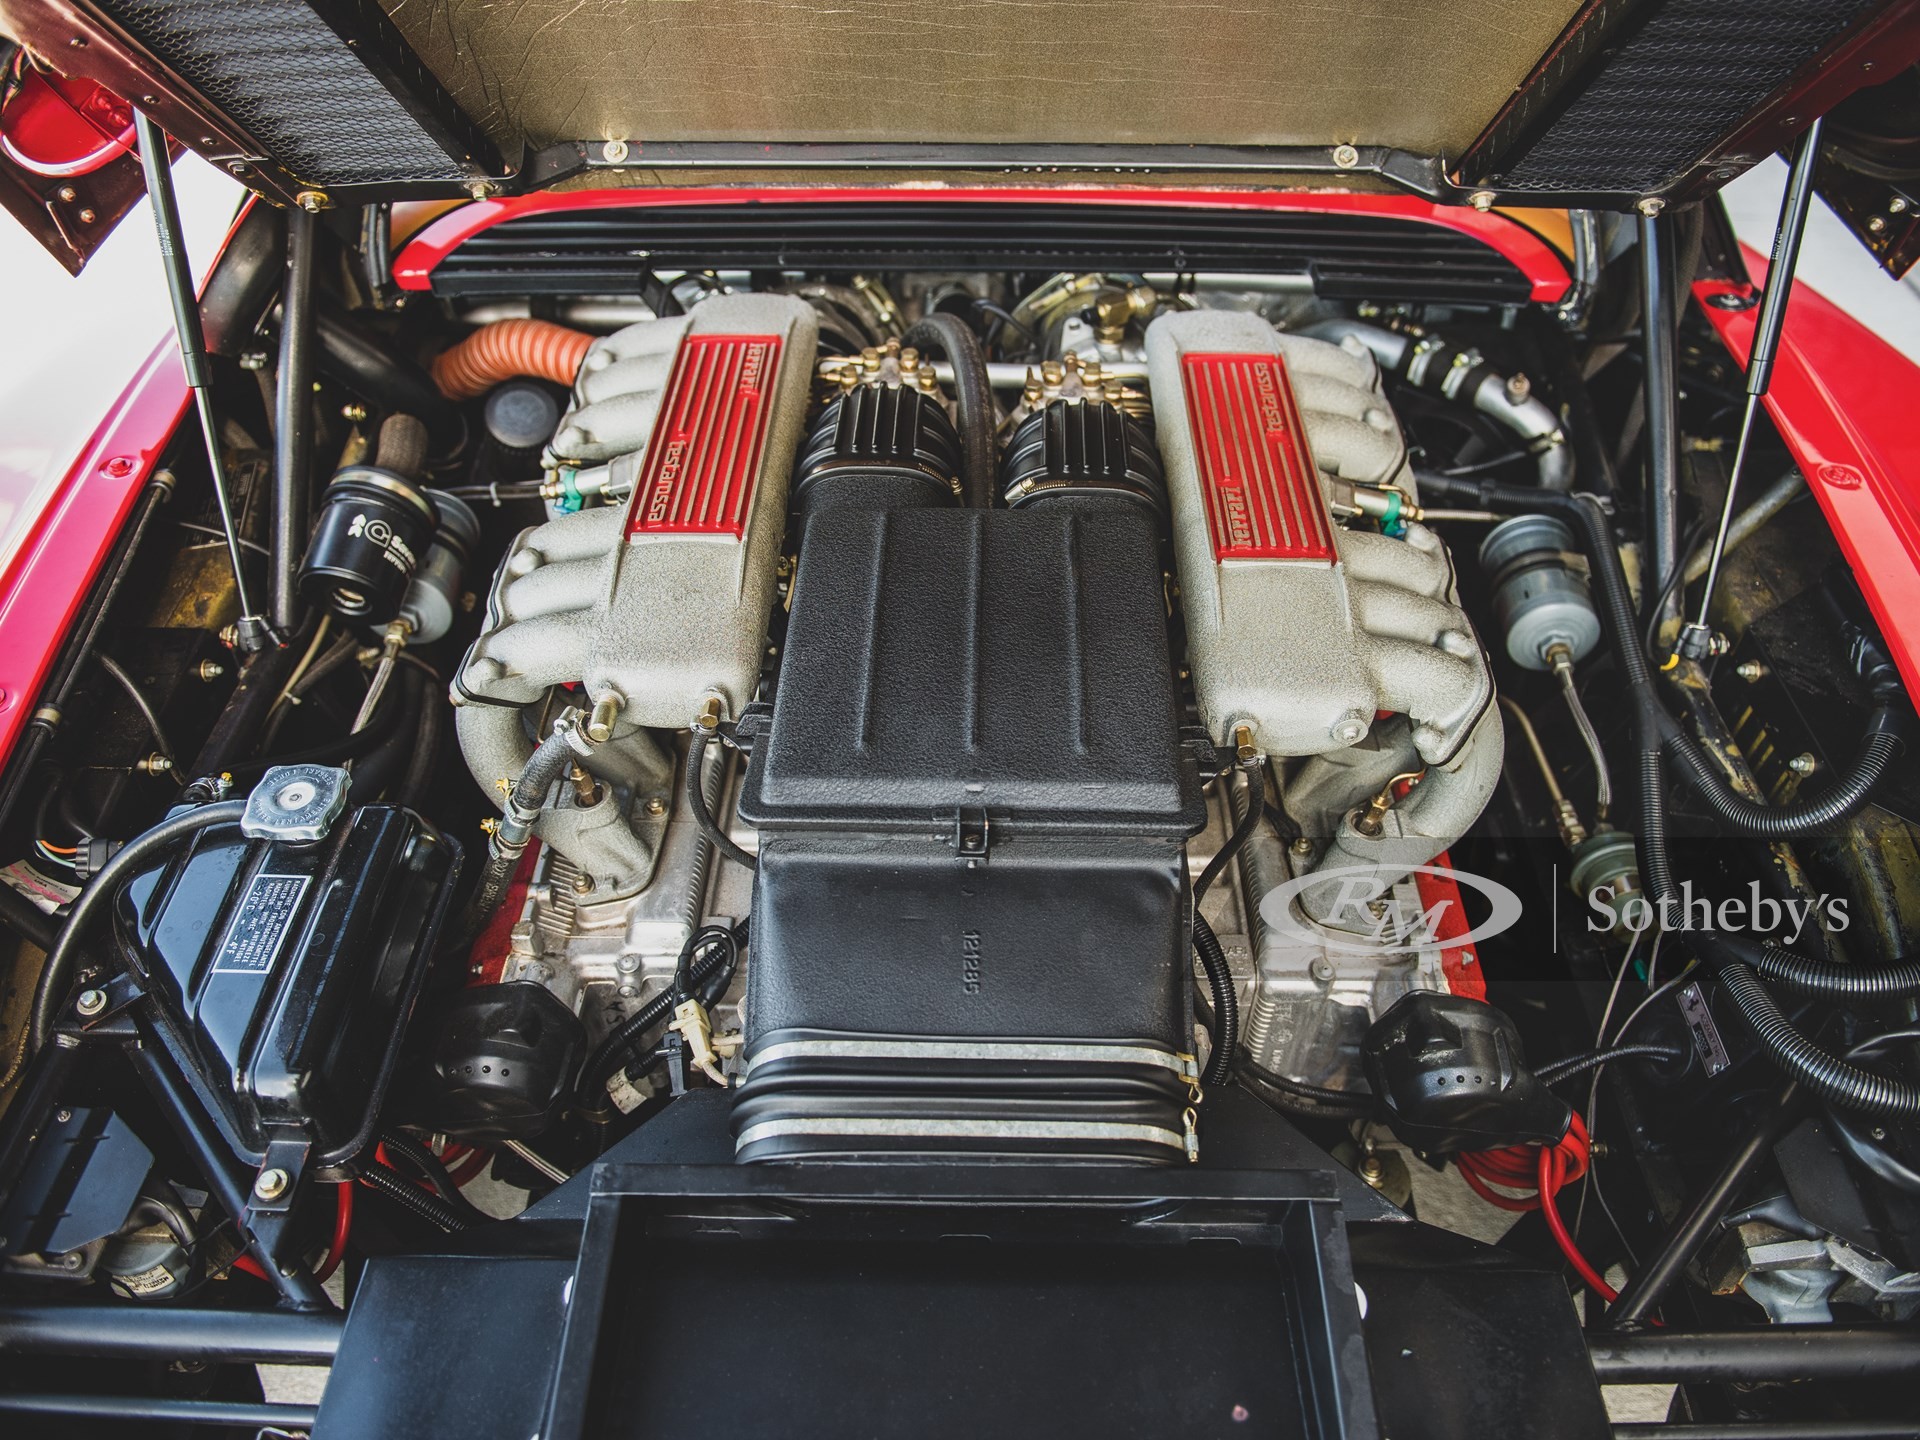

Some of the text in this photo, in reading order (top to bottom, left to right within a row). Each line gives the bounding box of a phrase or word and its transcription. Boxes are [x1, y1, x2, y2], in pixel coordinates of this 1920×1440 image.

[1254, 362, 1284, 433] testarossa
[648, 440, 685, 522] testarossa
[1221, 486, 1252, 547] Ferrari
[233, 882, 275, 963] RADIATEUR AVEC ANTIGEL
[258, 880, 301, 967] RADIATORE CON ANTICONGELANTE
[268, 882, 283, 906] RADIATOR
[241, 930, 261, 963] ANTIFREEZE
[963, 930, 981, 994] 121285
